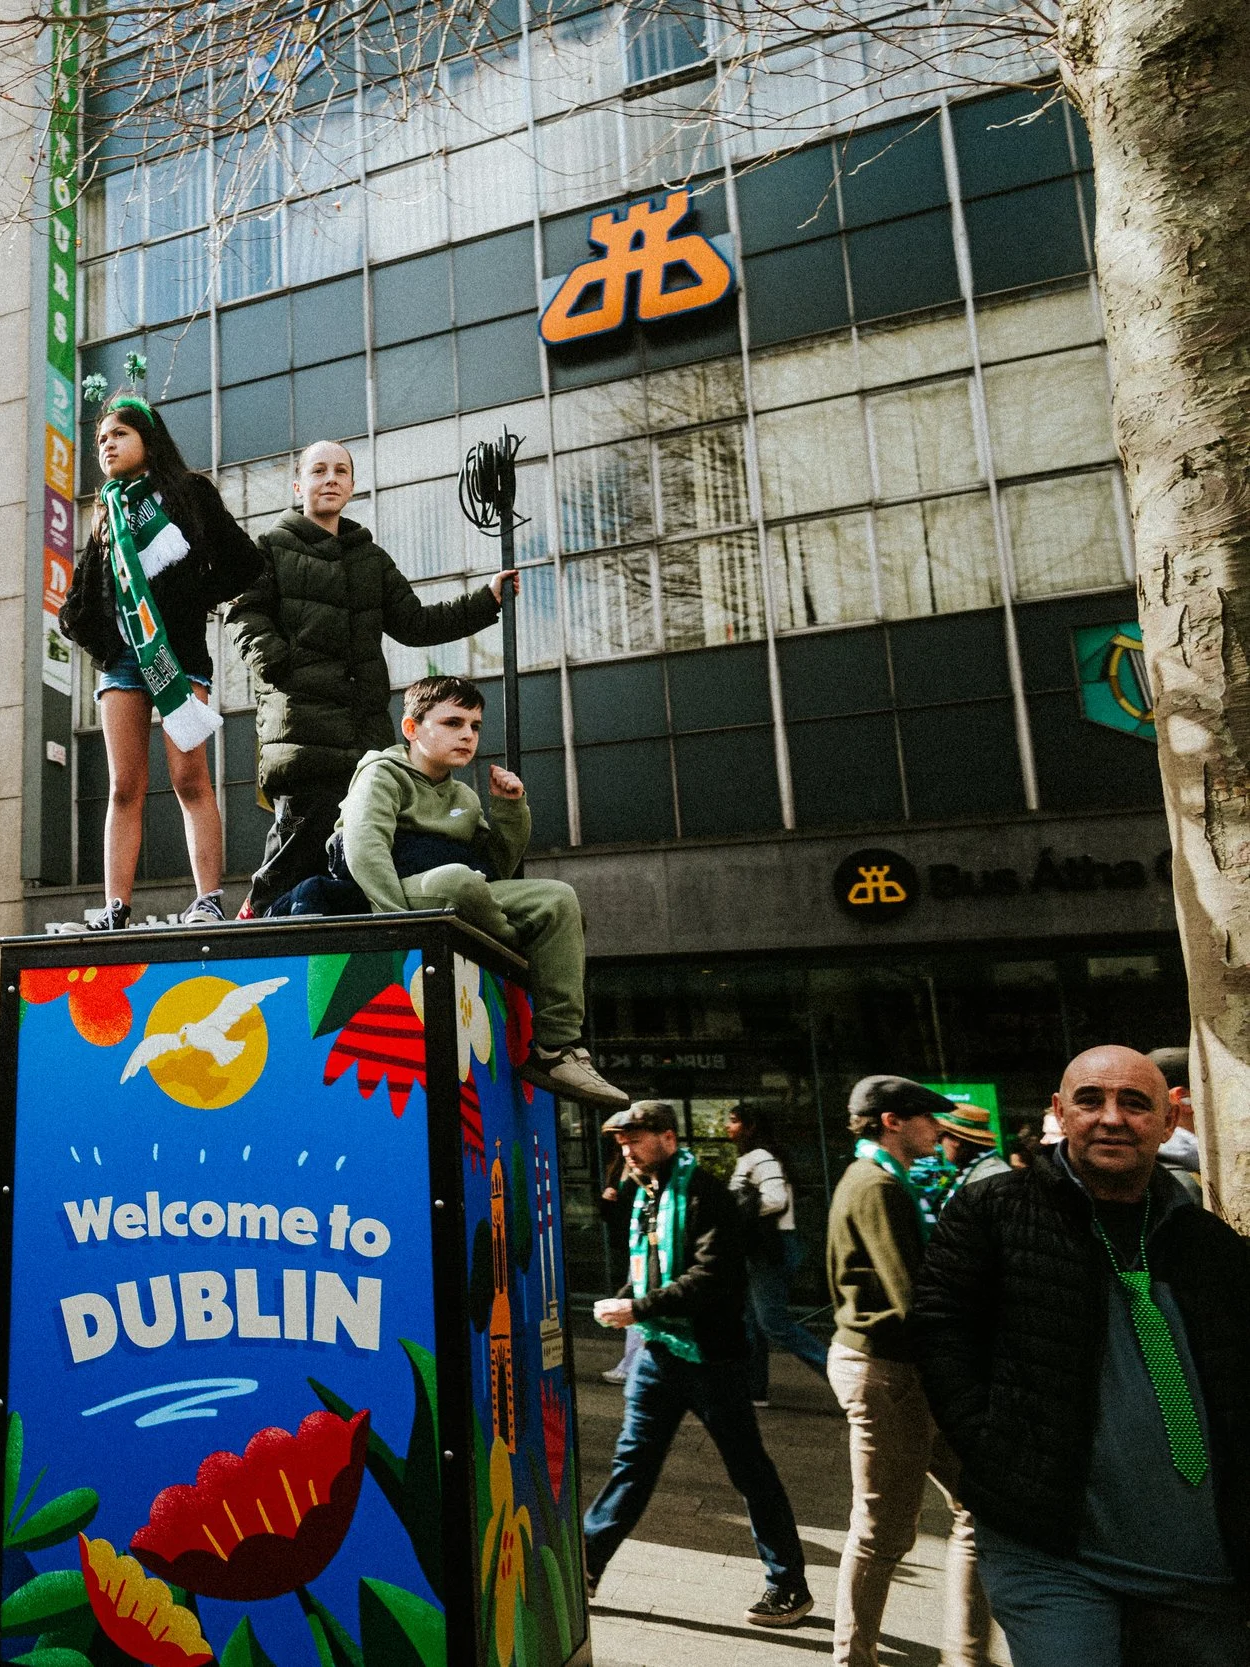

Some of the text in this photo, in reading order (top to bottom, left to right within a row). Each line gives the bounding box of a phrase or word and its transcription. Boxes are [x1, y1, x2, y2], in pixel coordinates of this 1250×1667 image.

[63, 1190, 392, 1259] Welcome to
[59, 1267, 383, 1364] DUBLIN
